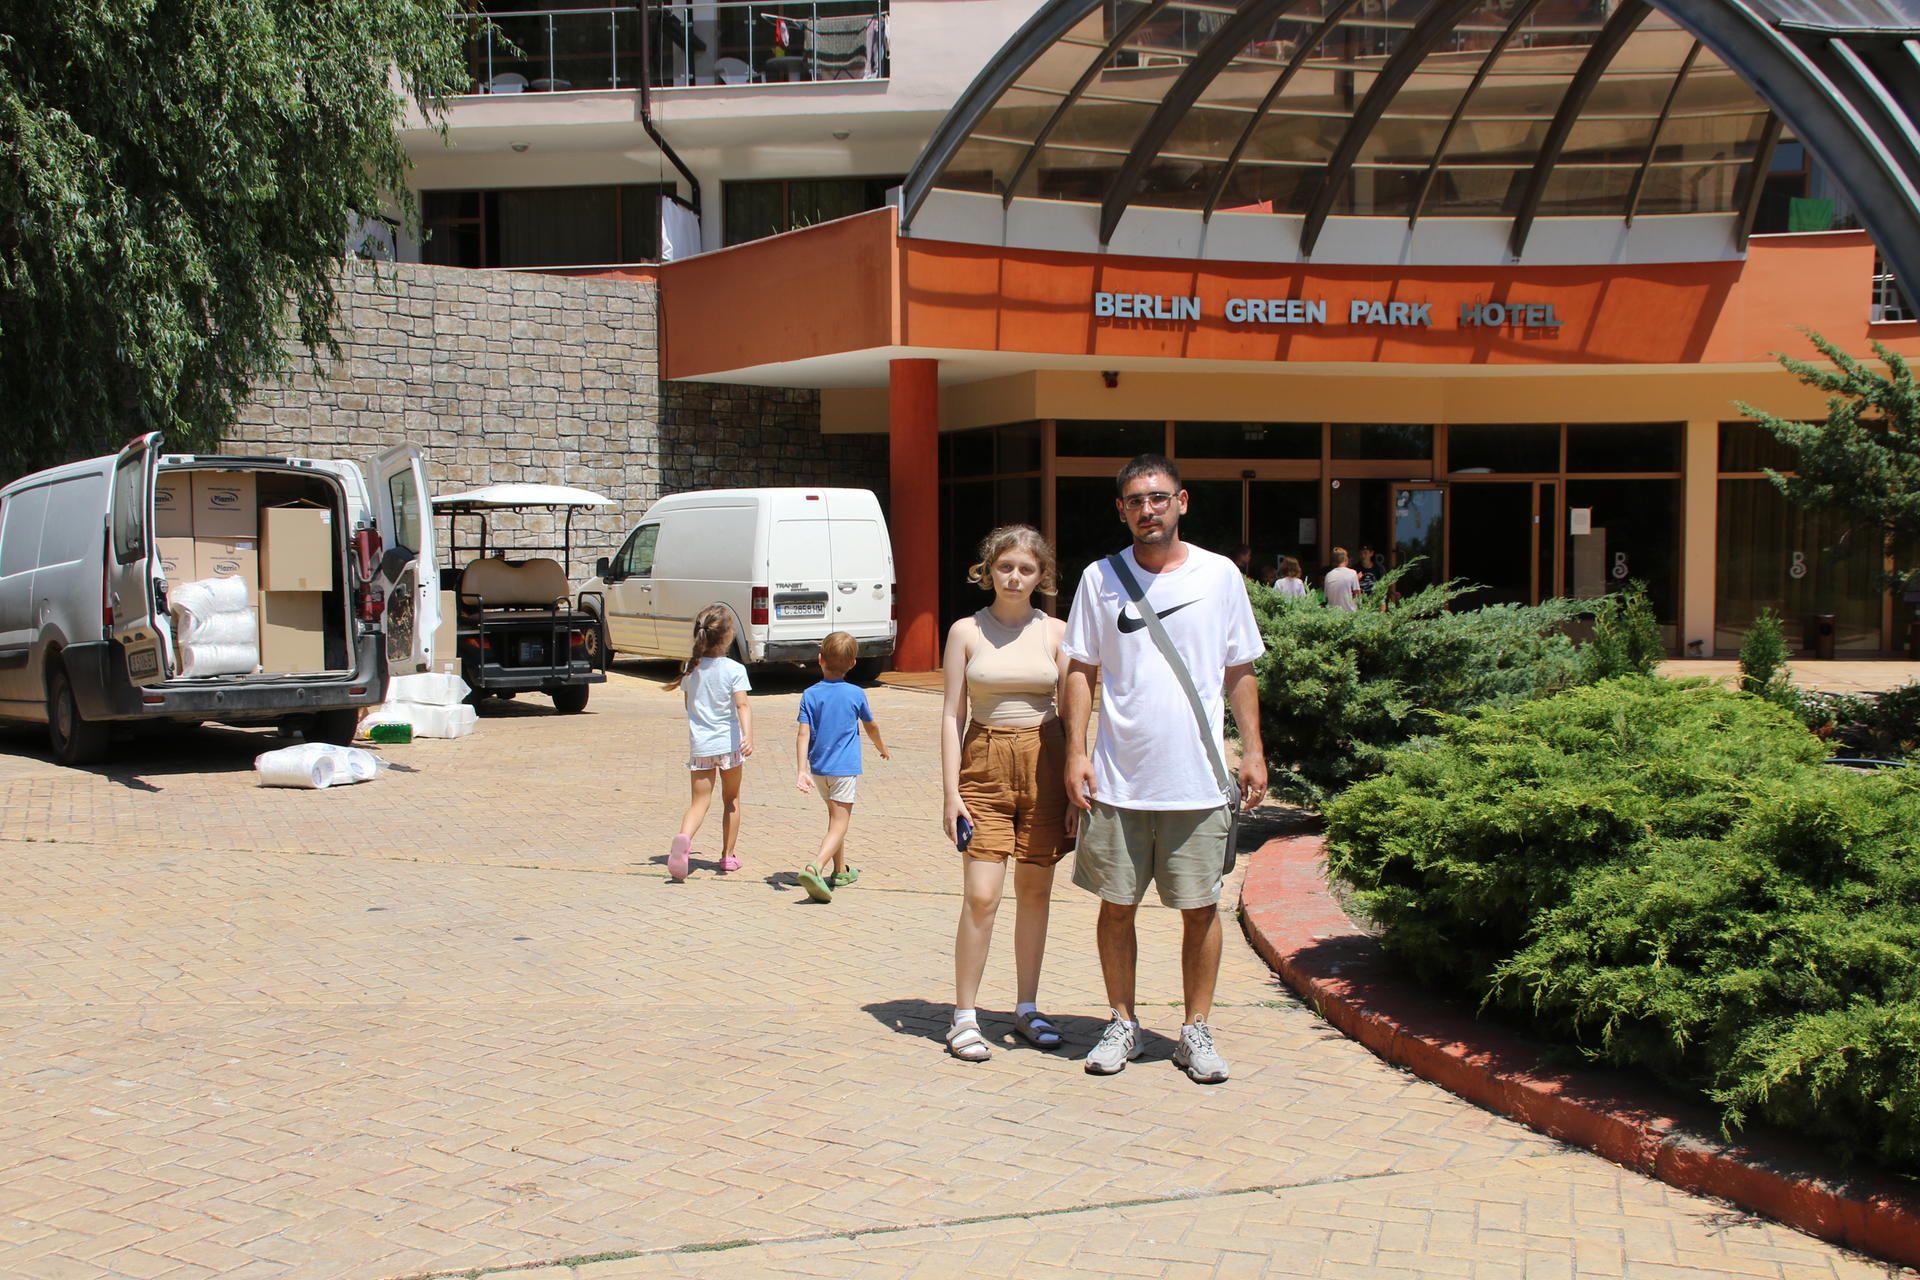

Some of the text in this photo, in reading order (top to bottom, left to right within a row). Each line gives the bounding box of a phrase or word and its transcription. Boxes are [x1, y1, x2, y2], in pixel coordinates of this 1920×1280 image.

[1095, 292, 1564, 326] BERLIN GREEN PARK HOTEL
